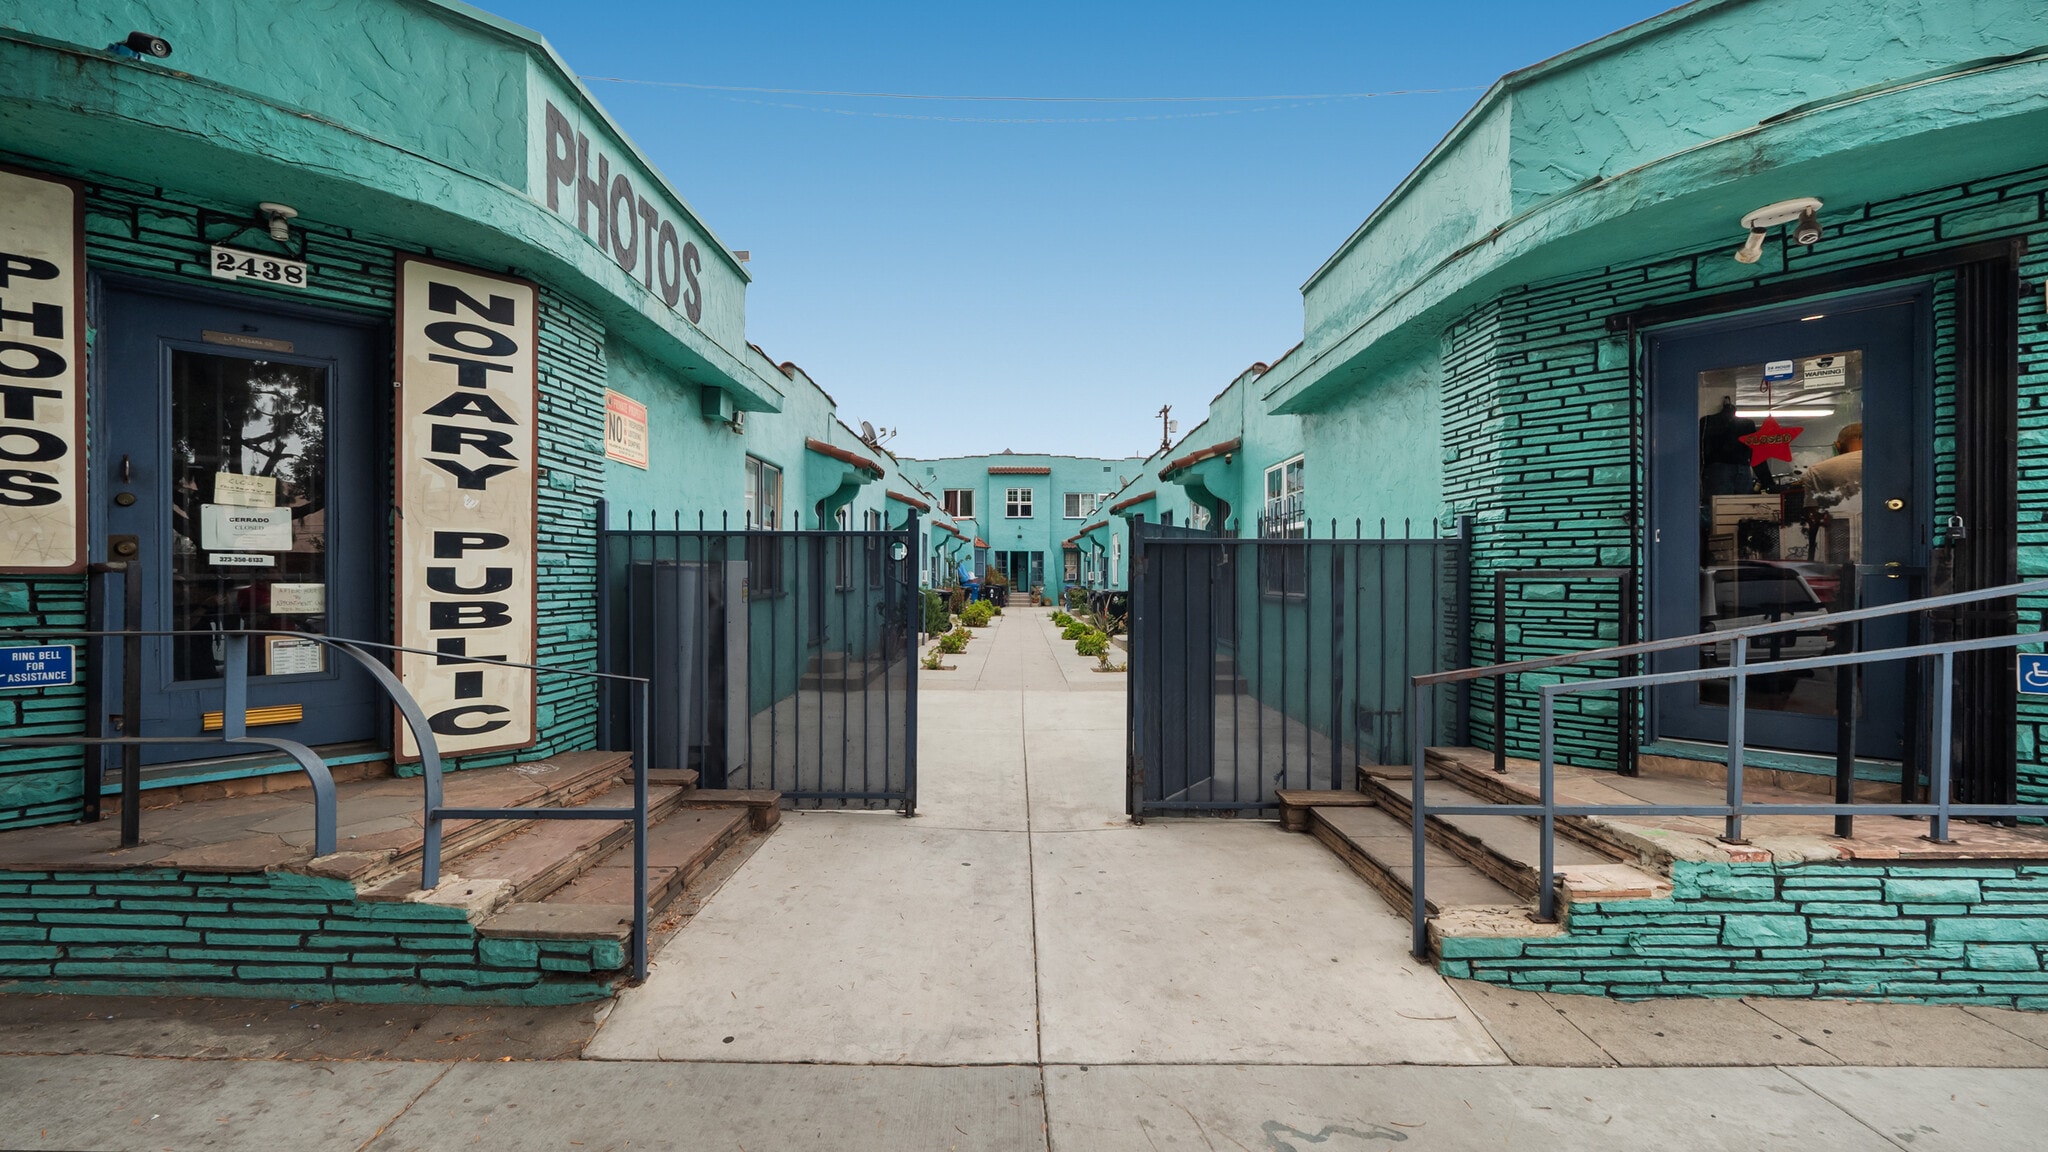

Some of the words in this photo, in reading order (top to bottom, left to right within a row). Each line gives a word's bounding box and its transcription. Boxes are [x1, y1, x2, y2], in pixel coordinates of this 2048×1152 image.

[545, 98, 702, 325] PHOTOS
[216, 252, 303, 284] 2438
[0, 253, 68, 507] PHOTOS
[422, 281, 520, 491] NOTARY
[608, 412, 622, 443] NO
[427, 531, 513, 736] PUBLIC
[12, 652, 35, 661] RING
[39, 650, 61, 660] BELL
[26, 661, 45, 671] FOR
[7, 670, 67, 683] ASSISTANCE
